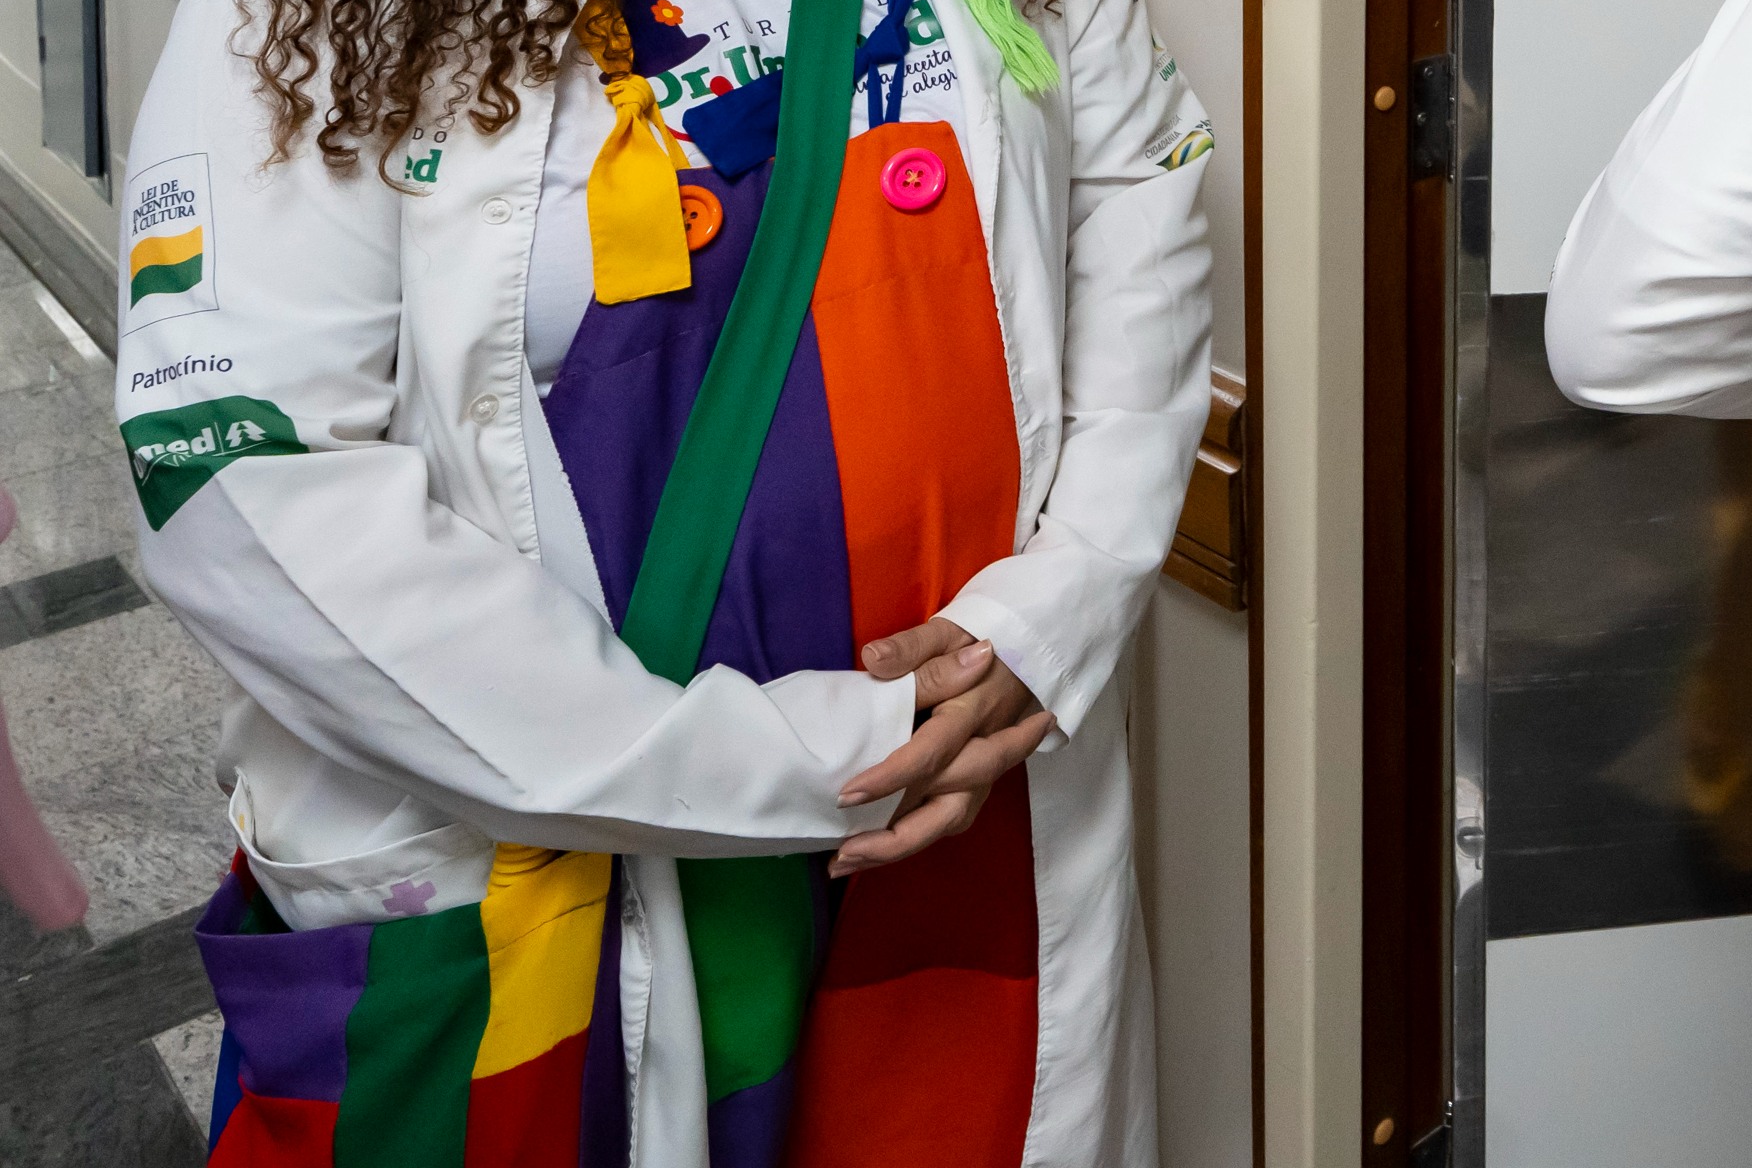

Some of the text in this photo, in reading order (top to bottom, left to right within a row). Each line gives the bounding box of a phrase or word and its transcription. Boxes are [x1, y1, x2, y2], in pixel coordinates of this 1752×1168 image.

[903, 49, 952, 78] eceita
[912, 68, 957, 94] alegr
[412, 126, 447, 144] DO
[1144, 131, 1182, 159] CIDADANIA
[141, 179, 179, 204] LEI DE
[139, 204, 196, 231] CULTURA
[131, 354, 233, 393] Patrocínio
